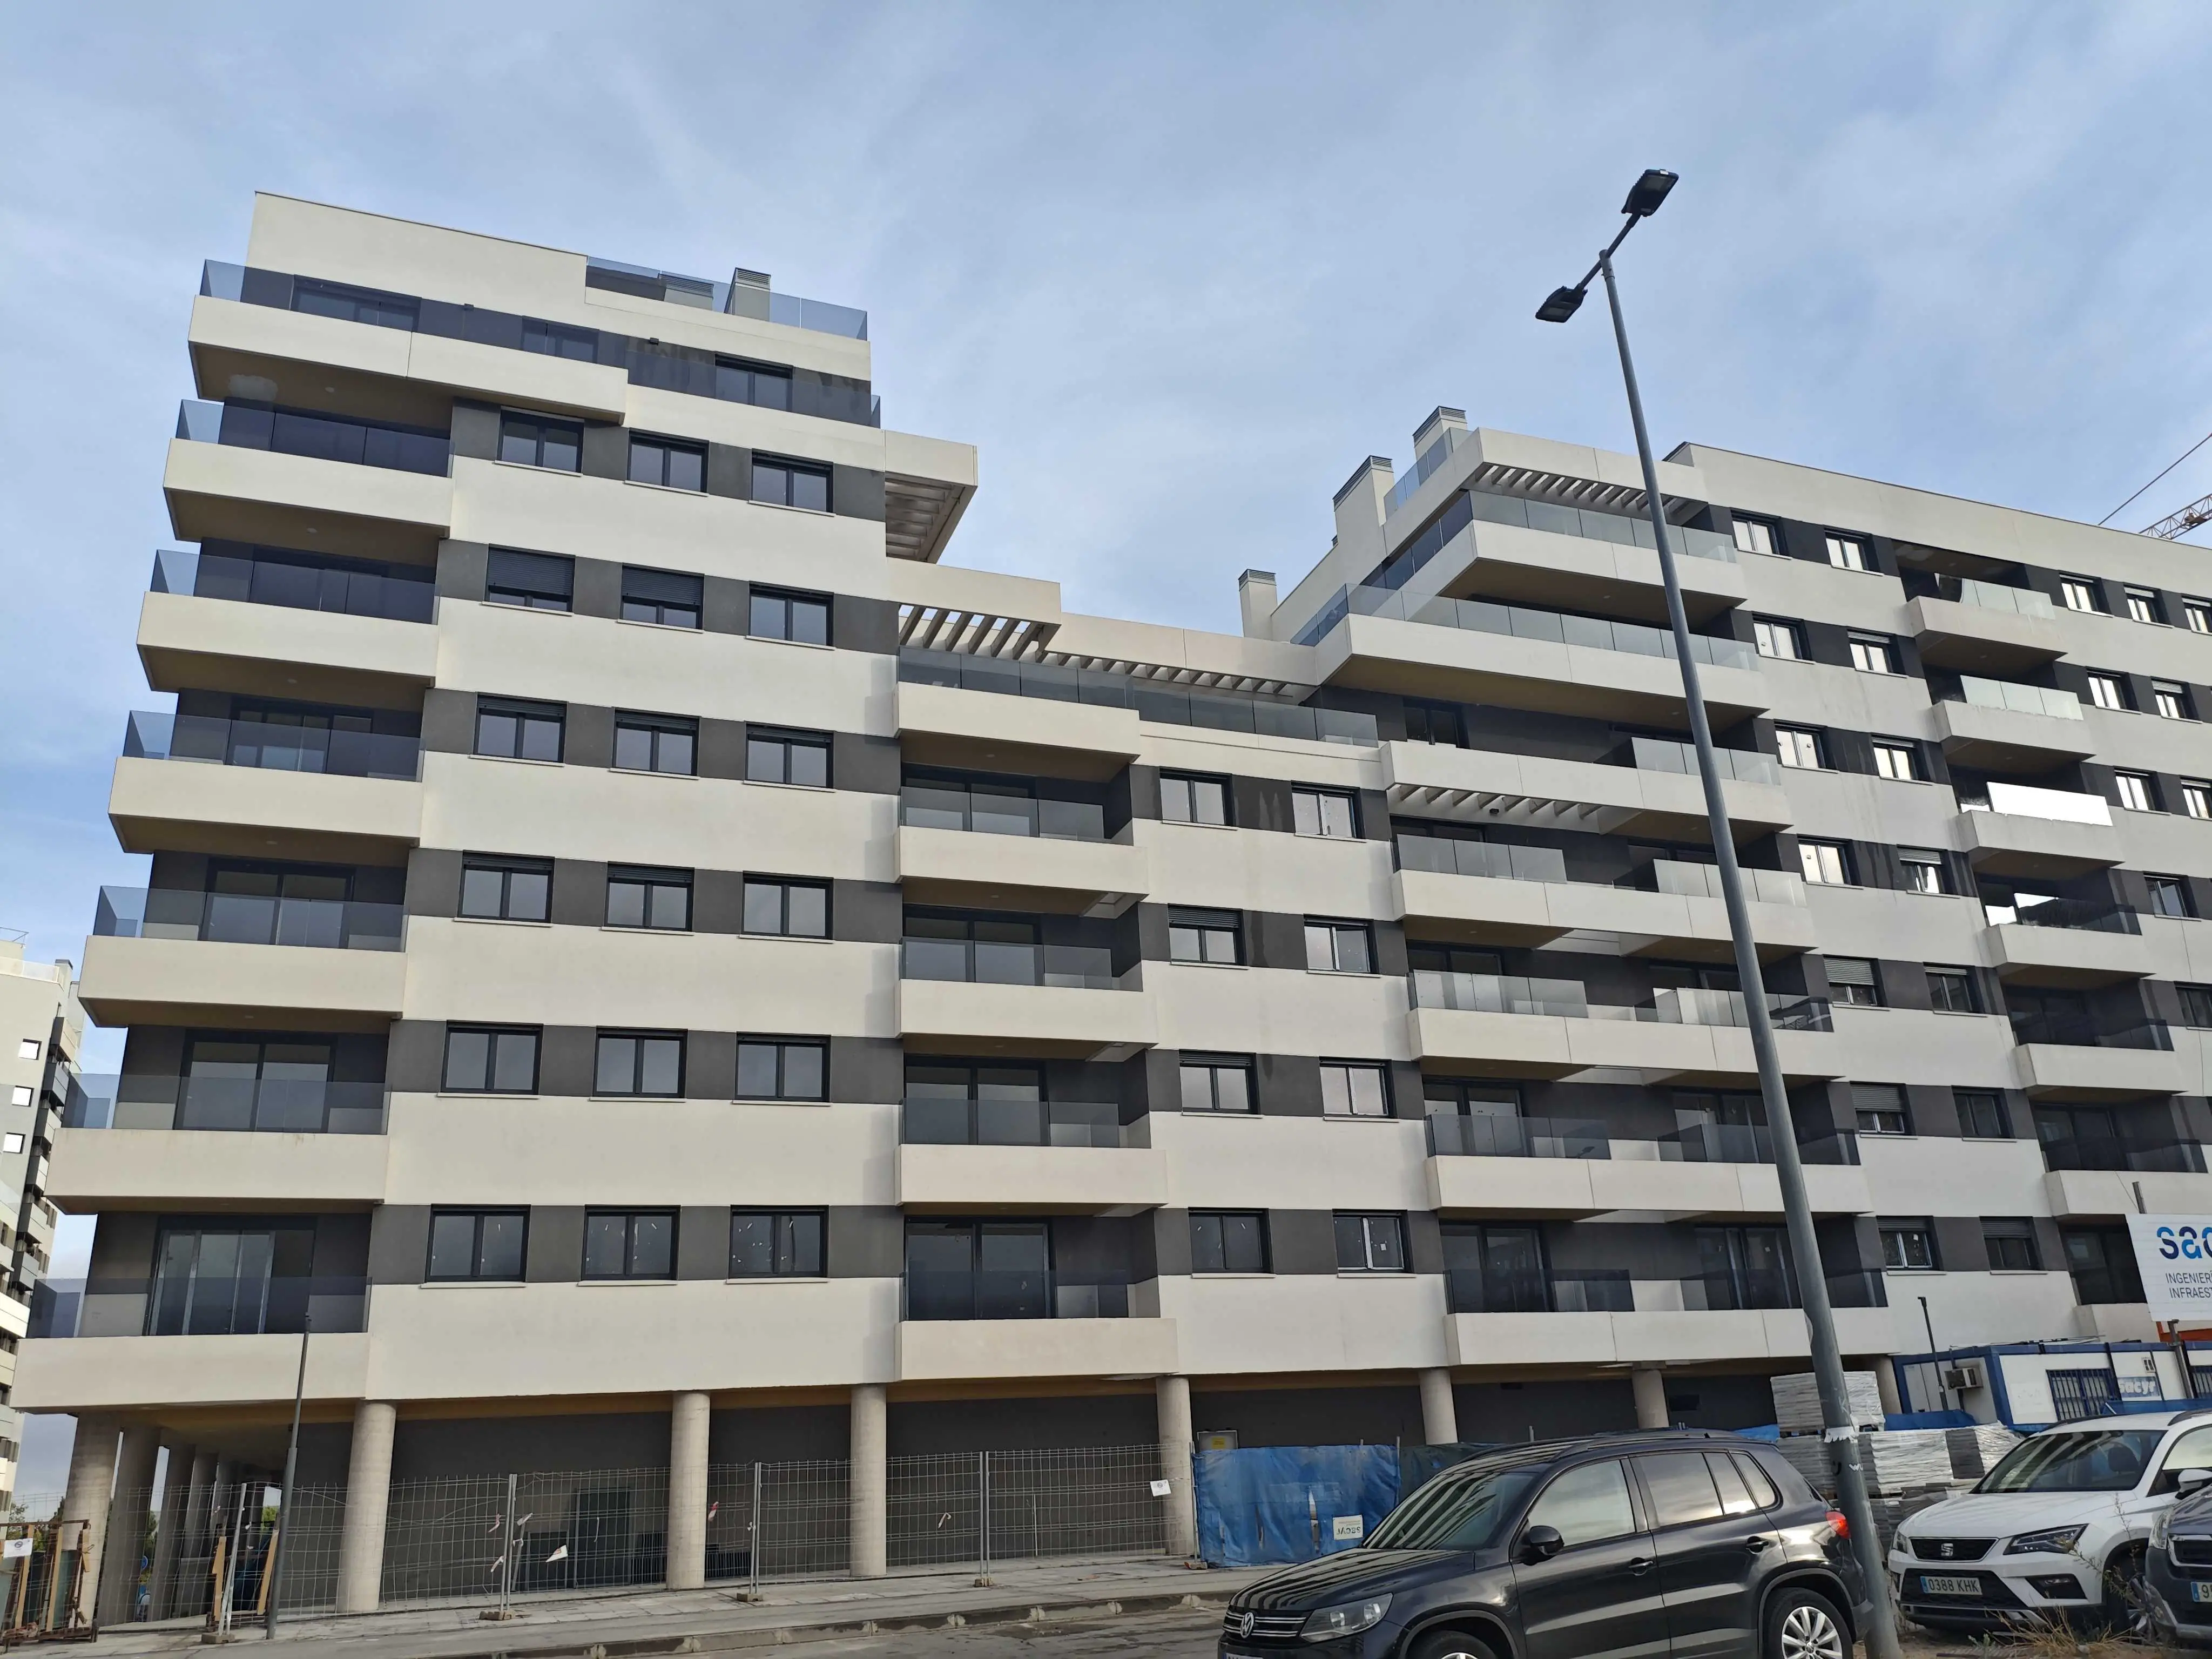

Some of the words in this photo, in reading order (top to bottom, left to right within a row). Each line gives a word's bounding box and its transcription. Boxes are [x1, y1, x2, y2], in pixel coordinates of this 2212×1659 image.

[2166, 1271, 2212, 1283] INGENIER
[1928, 1579, 1954, 1591] 0388
[1957, 1579, 1979, 1592] KHK
[2201, 1584, 2212, 1599] 9
